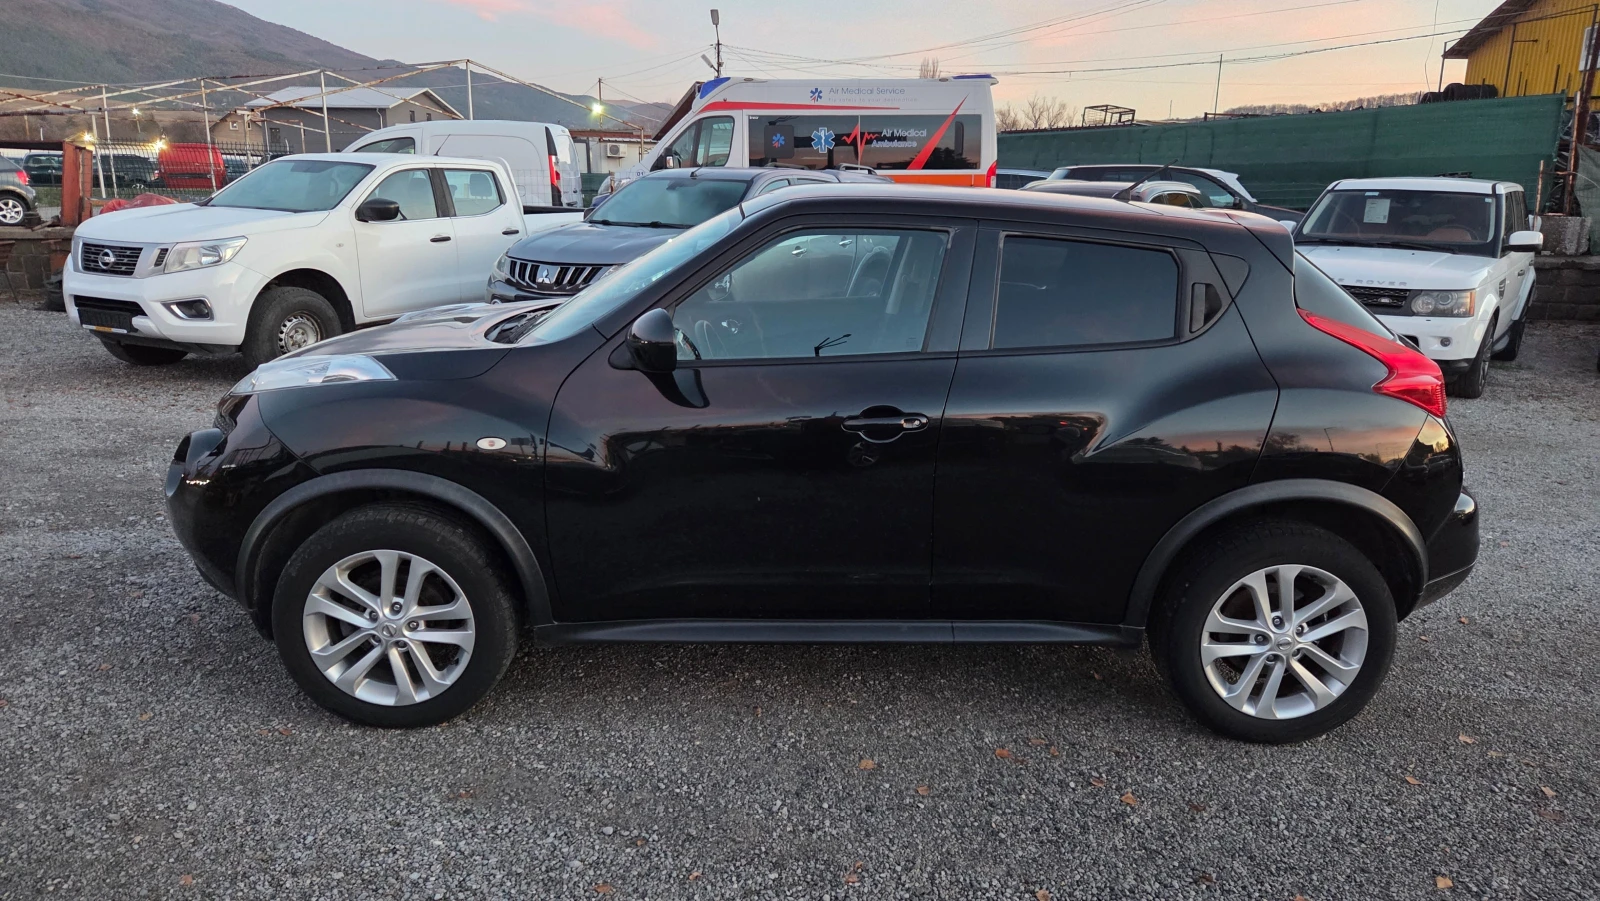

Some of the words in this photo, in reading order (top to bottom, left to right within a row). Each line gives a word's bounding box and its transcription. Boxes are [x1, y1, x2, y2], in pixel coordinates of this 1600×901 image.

[828, 87, 839, 95] Air
[841, 87, 873, 95] Medical
[876, 87, 906, 95] Service
[881, 128, 892, 137] Air
[893, 128, 927, 137] Medical
[871, 139, 918, 148] Ambulance
[1355, 279, 1408, 287] ROVER
